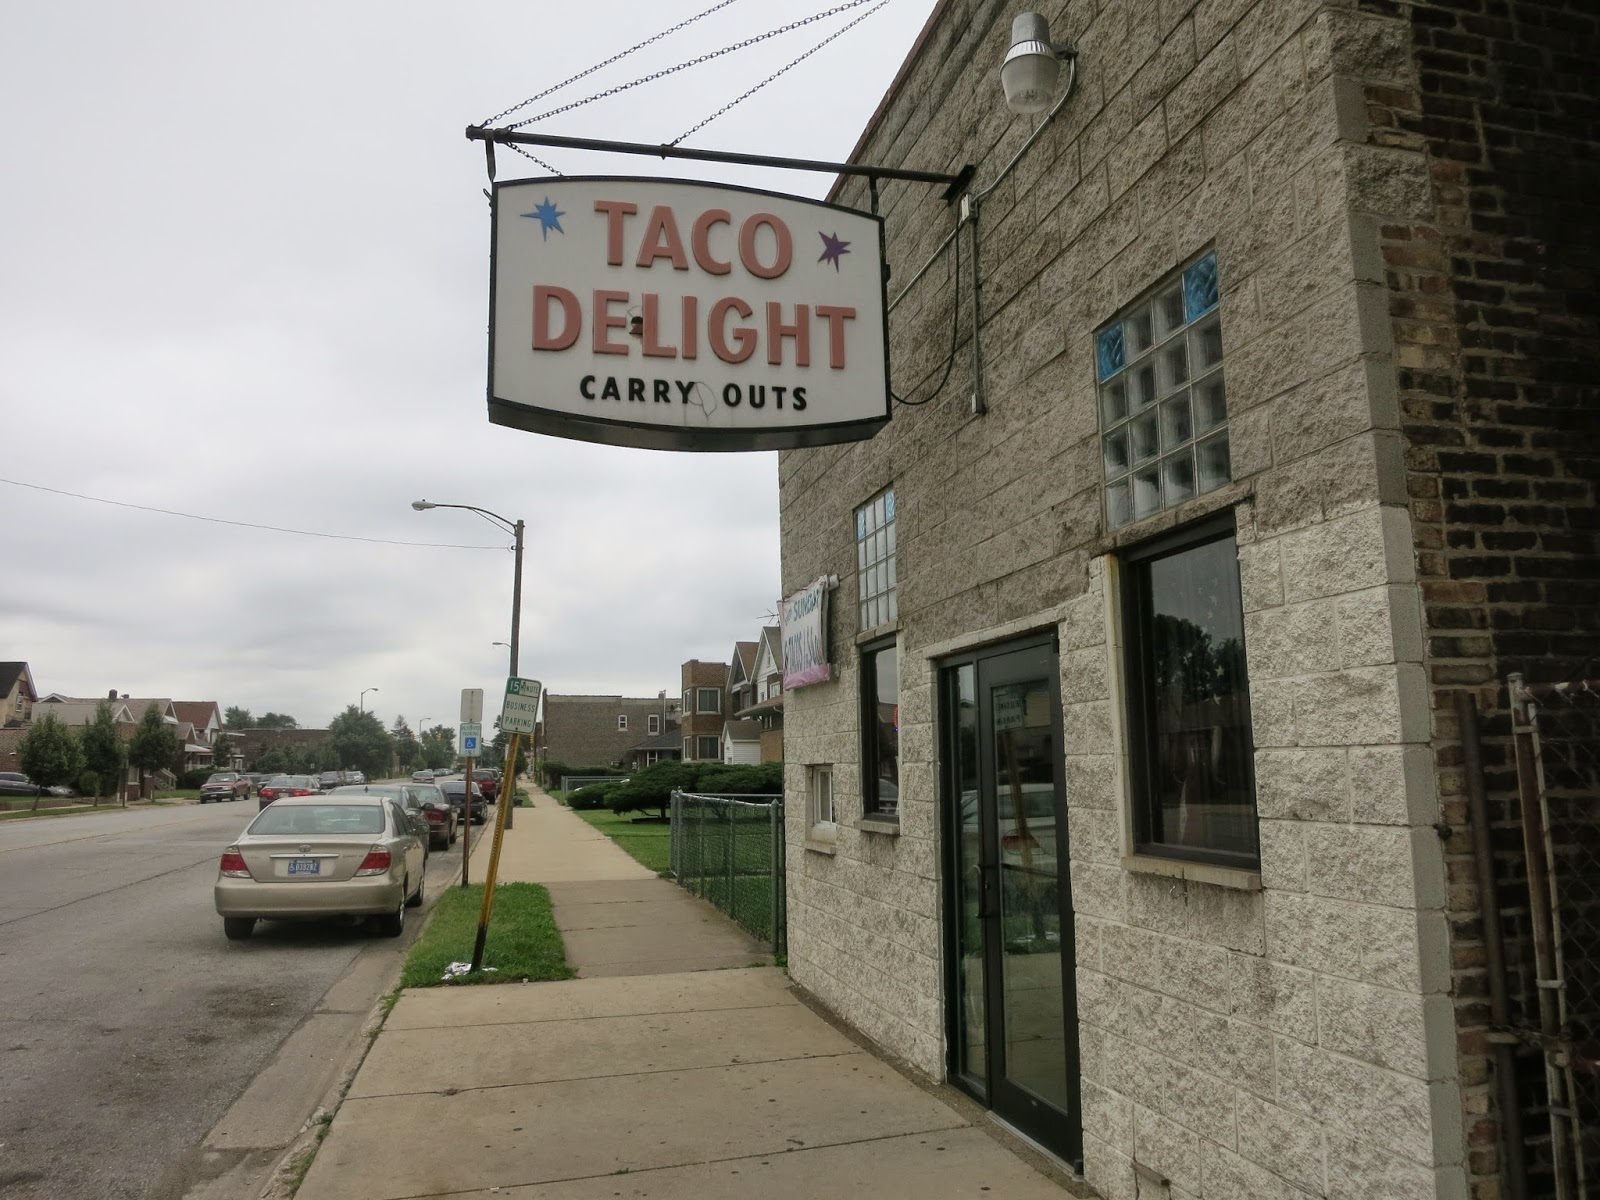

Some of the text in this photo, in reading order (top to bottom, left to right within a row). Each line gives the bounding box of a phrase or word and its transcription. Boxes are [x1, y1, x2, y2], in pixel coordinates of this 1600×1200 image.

[593, 199, 793, 280] TACO
[532, 285, 857, 370] DELIGHT
[580, 375, 808, 411] CARRY OUTS
[510, 681, 539, 694] 15 MINUTE
[505, 701, 536, 713] BUSINESS
[505, 716, 532, 728] PARKING
